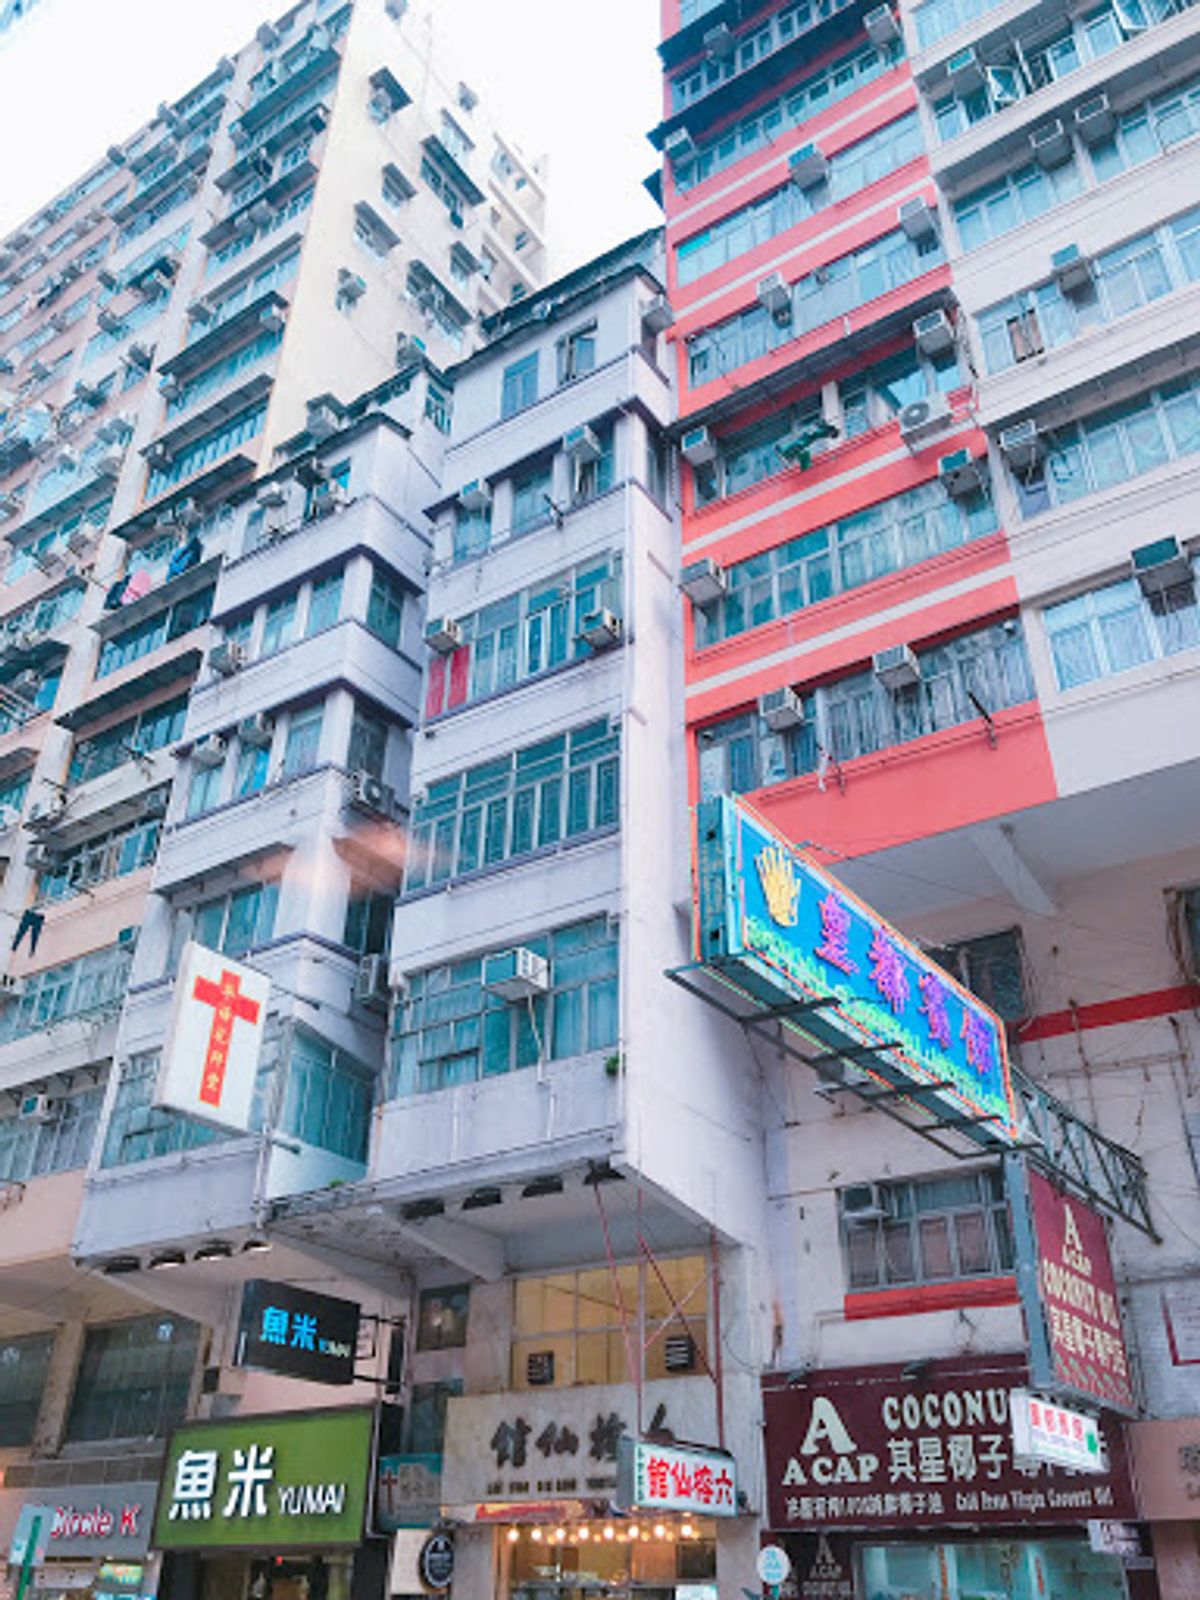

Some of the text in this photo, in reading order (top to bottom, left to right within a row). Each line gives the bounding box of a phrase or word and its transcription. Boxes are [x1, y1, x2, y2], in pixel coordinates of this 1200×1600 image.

[260, 1306, 317, 1351] 魚米
[800, 1397, 857, 1455] A
[882, 1387, 1008, 1431] COCONU
[168, 1444, 275, 1520] 魚米
[278, 1484, 346, 1515] YUMAI
[119, 1504, 142, 1536] K
